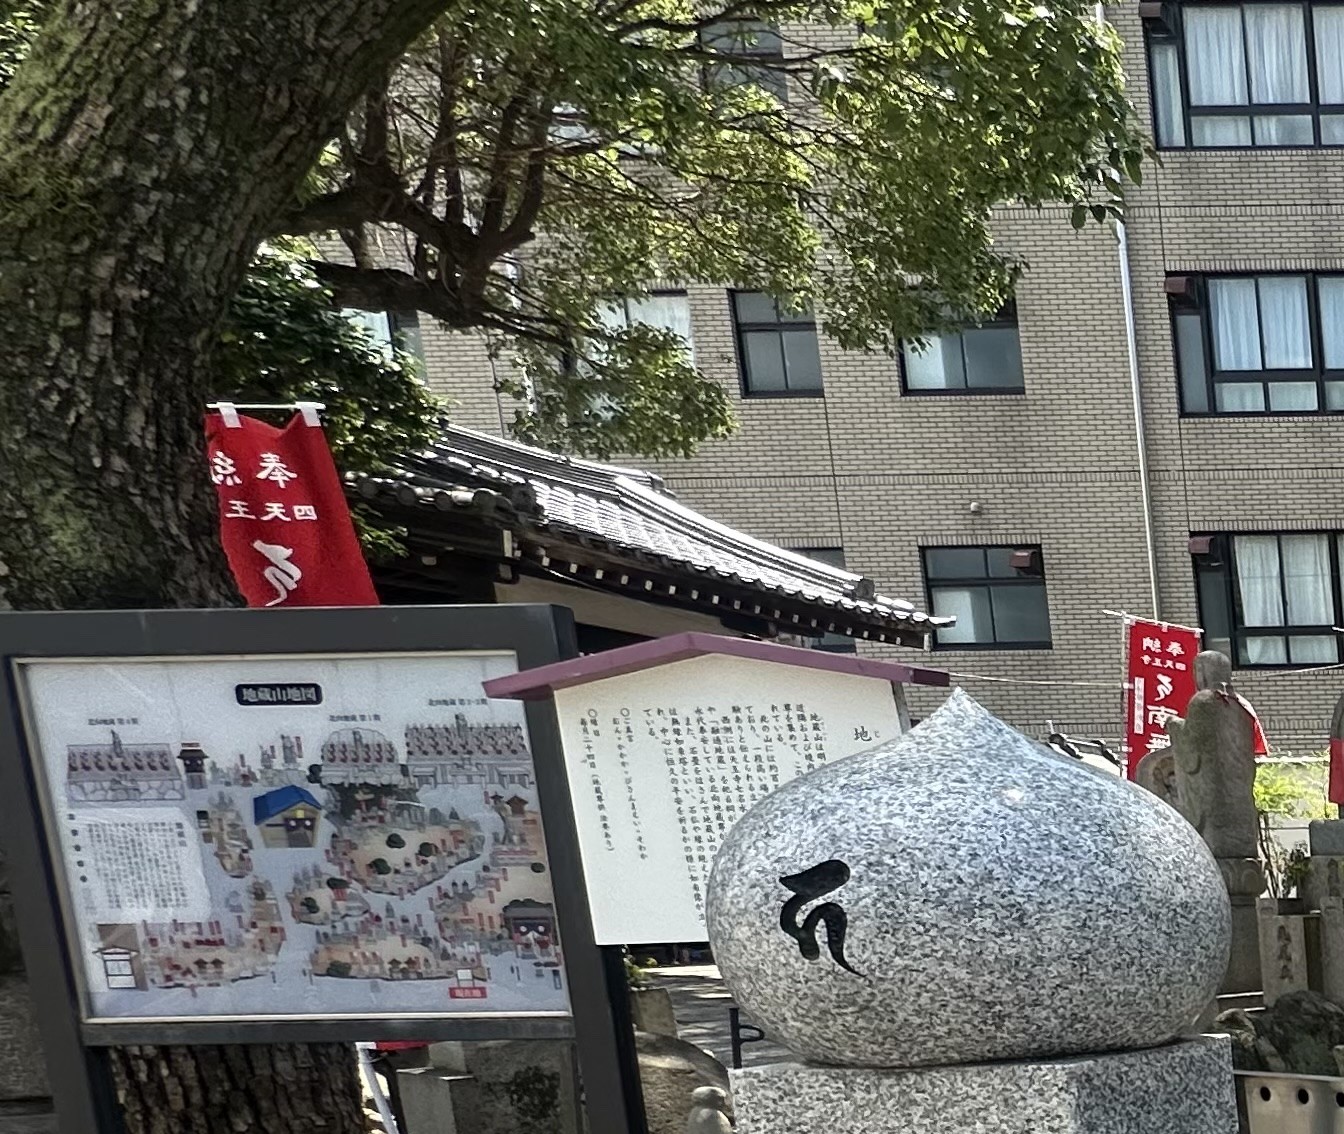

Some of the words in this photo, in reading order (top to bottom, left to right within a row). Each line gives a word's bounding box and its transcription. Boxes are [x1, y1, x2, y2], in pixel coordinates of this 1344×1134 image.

[810, 712, 827, 767] 地蔵山は明
